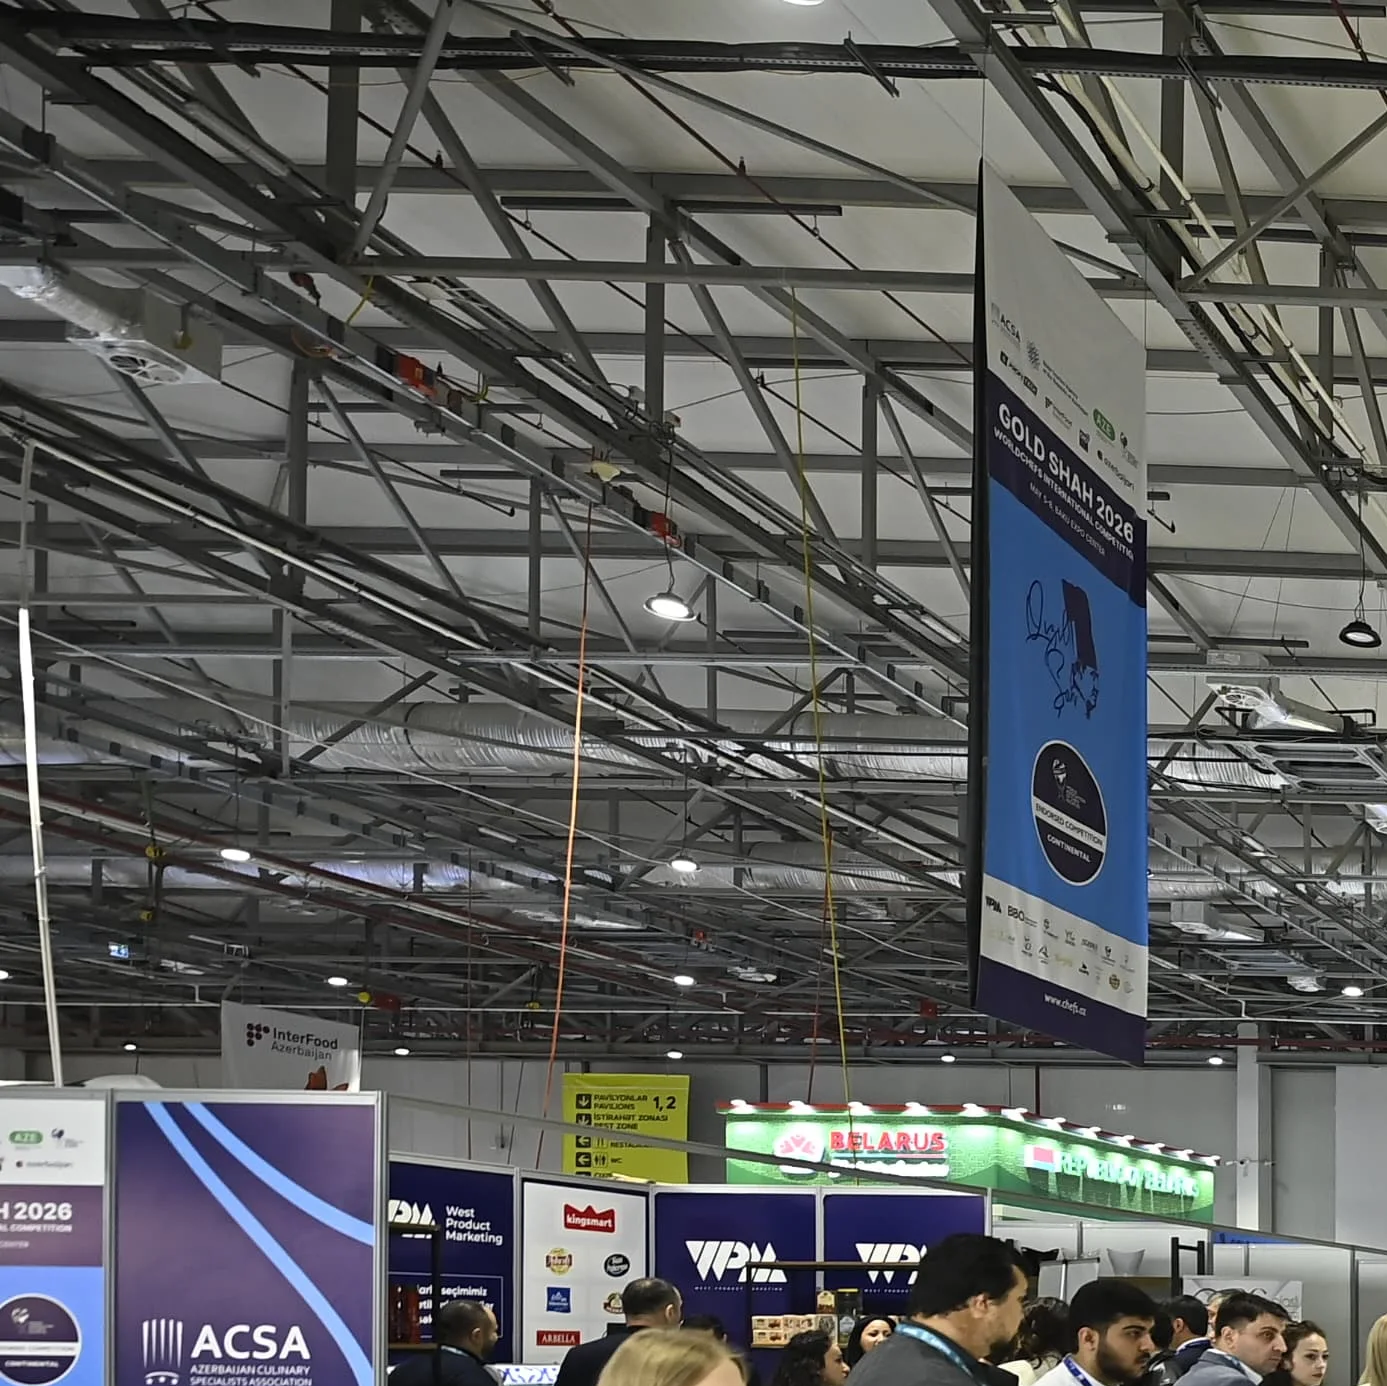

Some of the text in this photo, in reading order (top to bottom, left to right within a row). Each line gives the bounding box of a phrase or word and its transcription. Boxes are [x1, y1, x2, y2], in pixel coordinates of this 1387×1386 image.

[993, 426, 1043, 479] WORLDCHEFS
[1043, 471, 1094, 527] INTERNATIONAL
[999, 403, 1045, 462] GOLD
[1048, 451, 1093, 509] SHAH
[1096, 495, 1134, 544] 2026
[1035, 801, 1064, 829] ENDORSED
[1047, 833, 1092, 864] CONTINENTAL
[273, 1027, 338, 1050] InterFood
[271, 1041, 332, 1060] Azerbaijan
[616, 1122, 638, 1130] ZONE
[830, 1131, 945, 1151] BELARUS
[13, 1202, 73, 1221] 2026
[445, 1205, 475, 1218] West
[566, 1213, 613, 1228] kingsmart
[445, 1217, 491, 1231] Product
[445, 1230, 503, 1246] Marketing
[855, 1243, 928, 1285] WP
[190, 1324, 312, 1359] ACSA
[542, 1333, 576, 1342] ARBELLA
[190, 1364, 311, 1376] AZERBAIJAN CULINARY
[190, 1377, 248, 1386] SPECIALISTS
